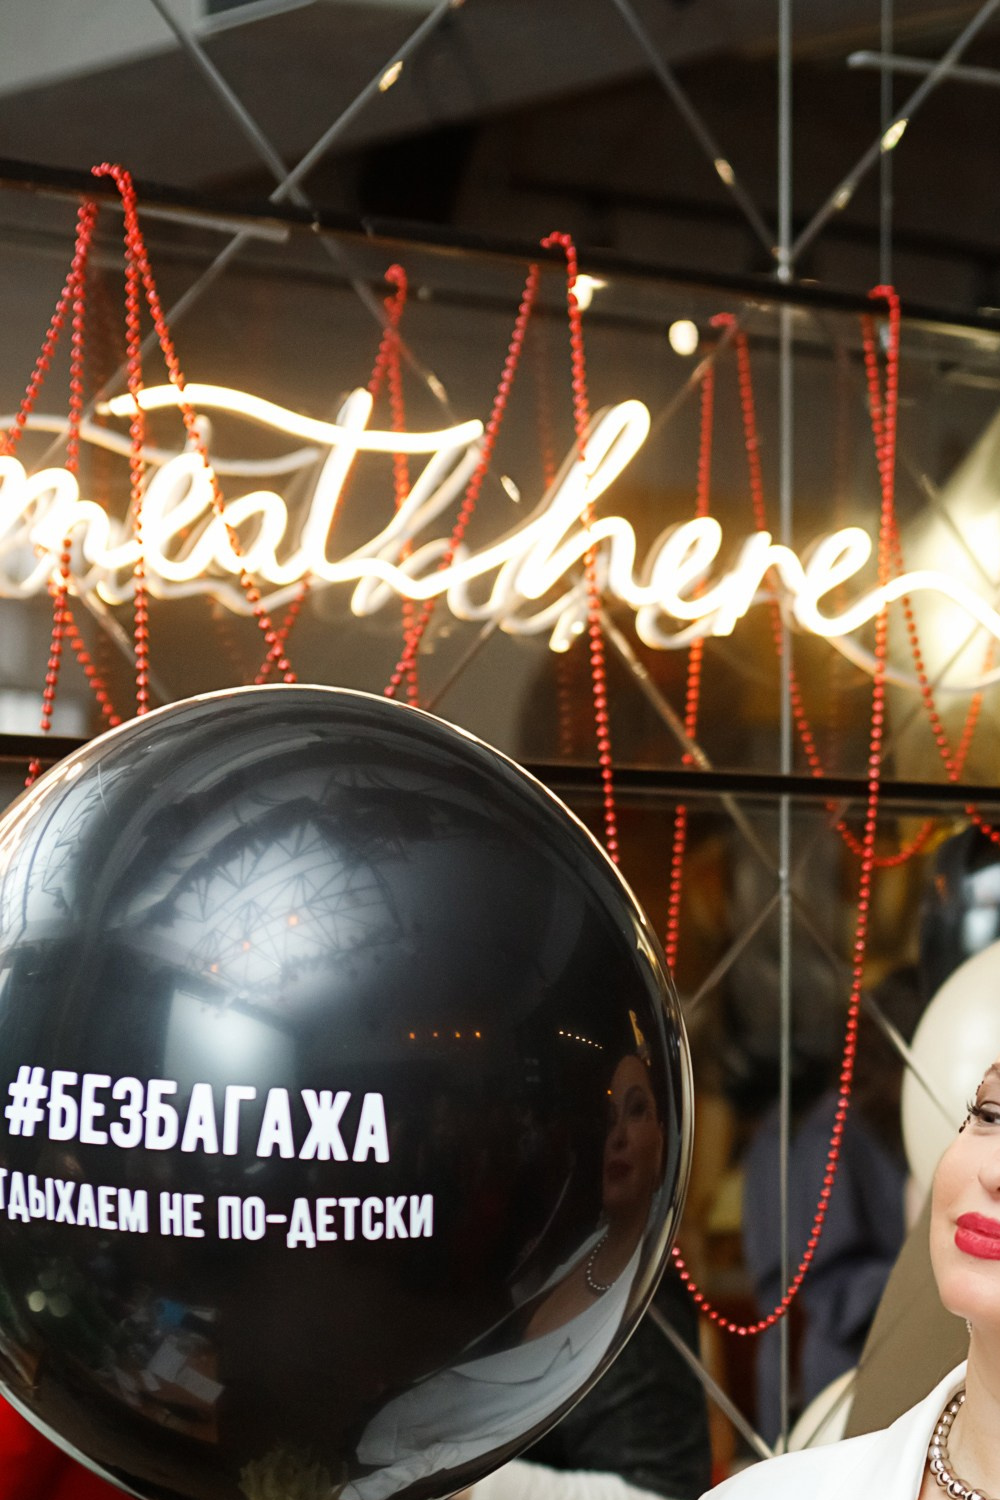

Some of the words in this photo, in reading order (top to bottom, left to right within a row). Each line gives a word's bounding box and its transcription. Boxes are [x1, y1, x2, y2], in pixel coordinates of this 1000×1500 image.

[4, 1065, 390, 1163] #БЕЗБАГАЖА
[159, 1191, 205, 1238] НЕ
[217, 1193, 434, 1249] ПО-ДЕТСКИ
